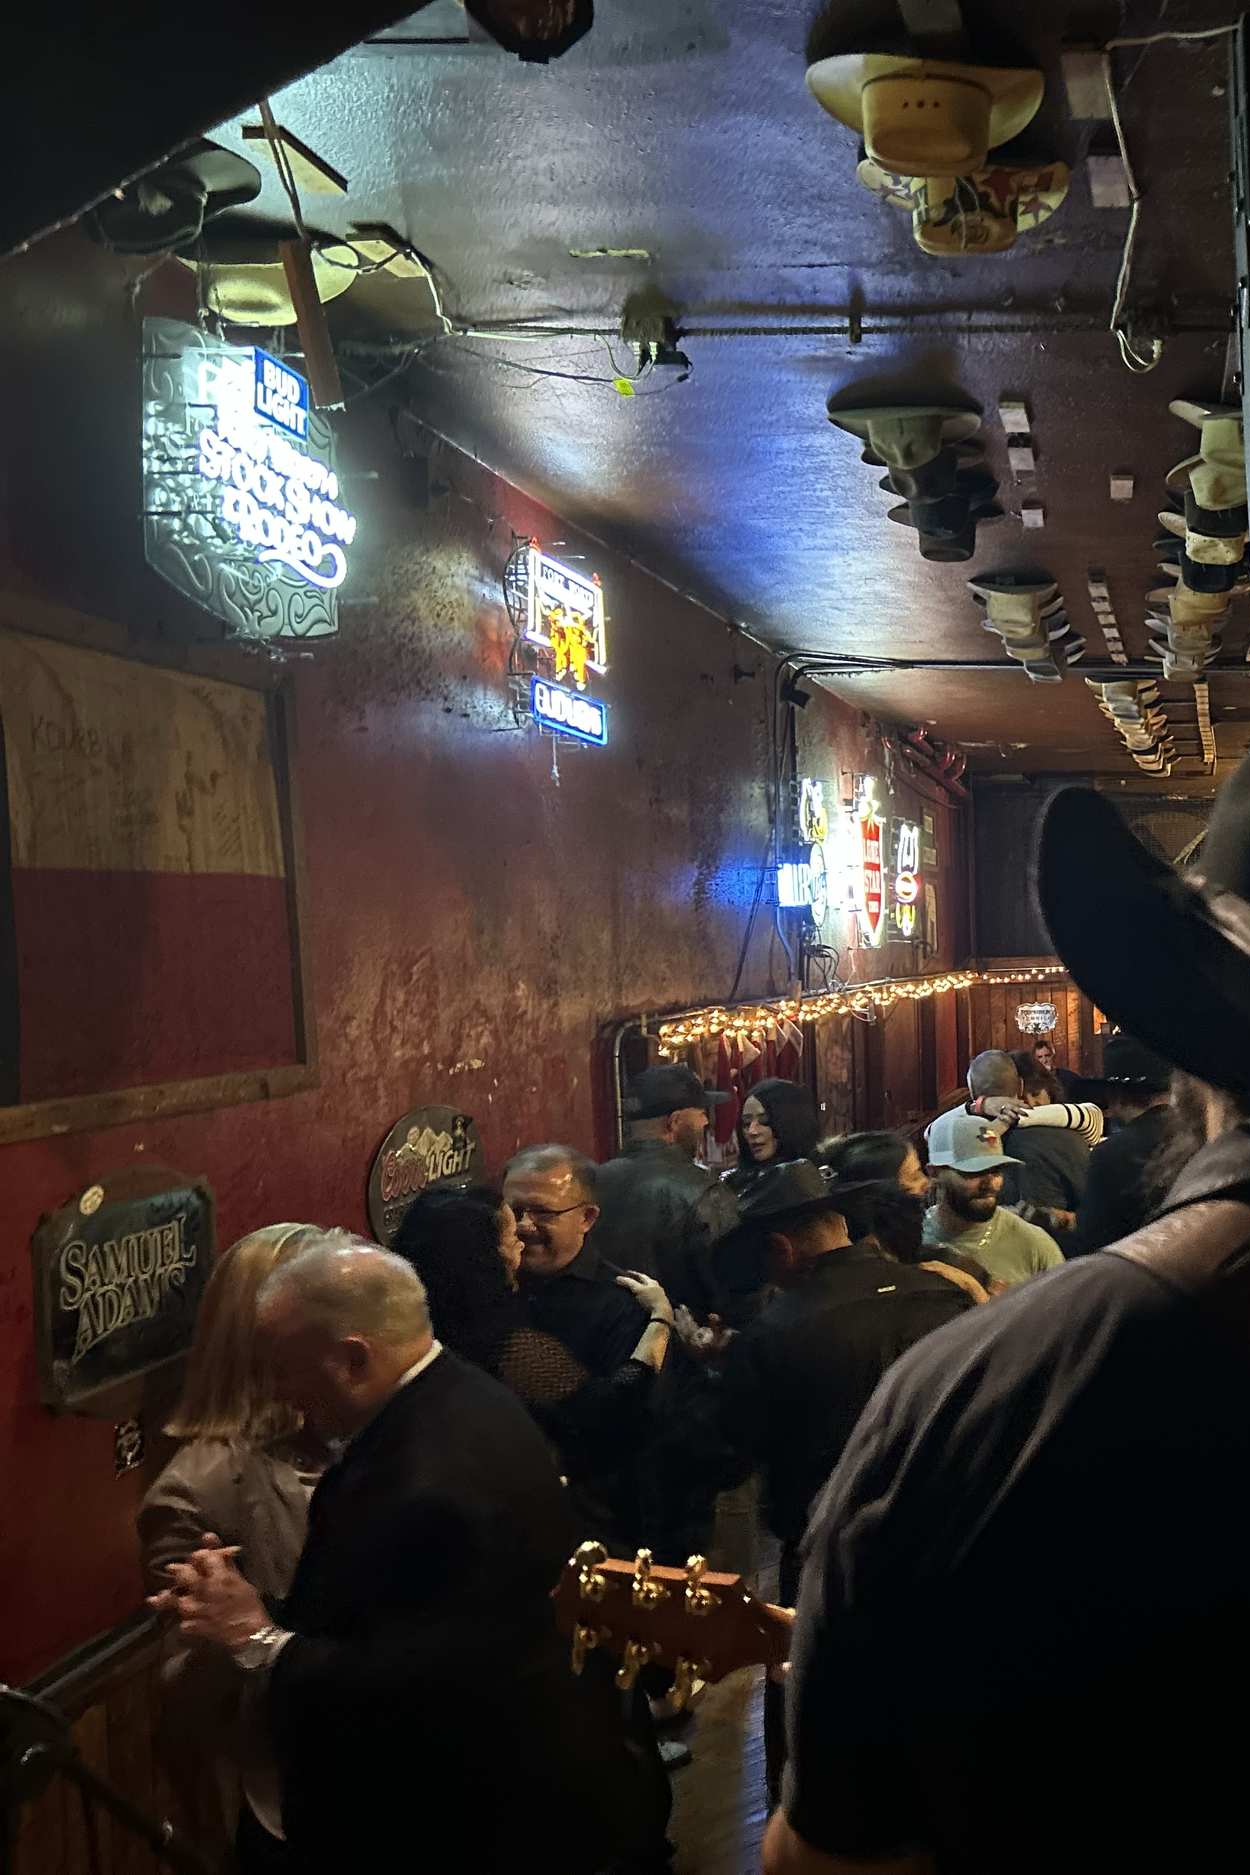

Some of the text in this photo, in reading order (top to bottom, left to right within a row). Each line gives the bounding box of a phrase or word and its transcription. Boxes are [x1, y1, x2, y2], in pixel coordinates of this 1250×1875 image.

[263, 359, 300, 404] BUD
[256, 382, 308, 436] LIGHT
[199, 429, 287, 511] STOCK
[284, 470, 357, 545] SHOW
[542, 566, 565, 588] FORT
[863, 838, 880, 863] LONE
[864, 869, 881, 894] STAR
[428, 1142, 476, 1182] LIGHT
[60, 1213, 197, 1311] SAMUEL
[71, 1263, 188, 1365] ADAMS
